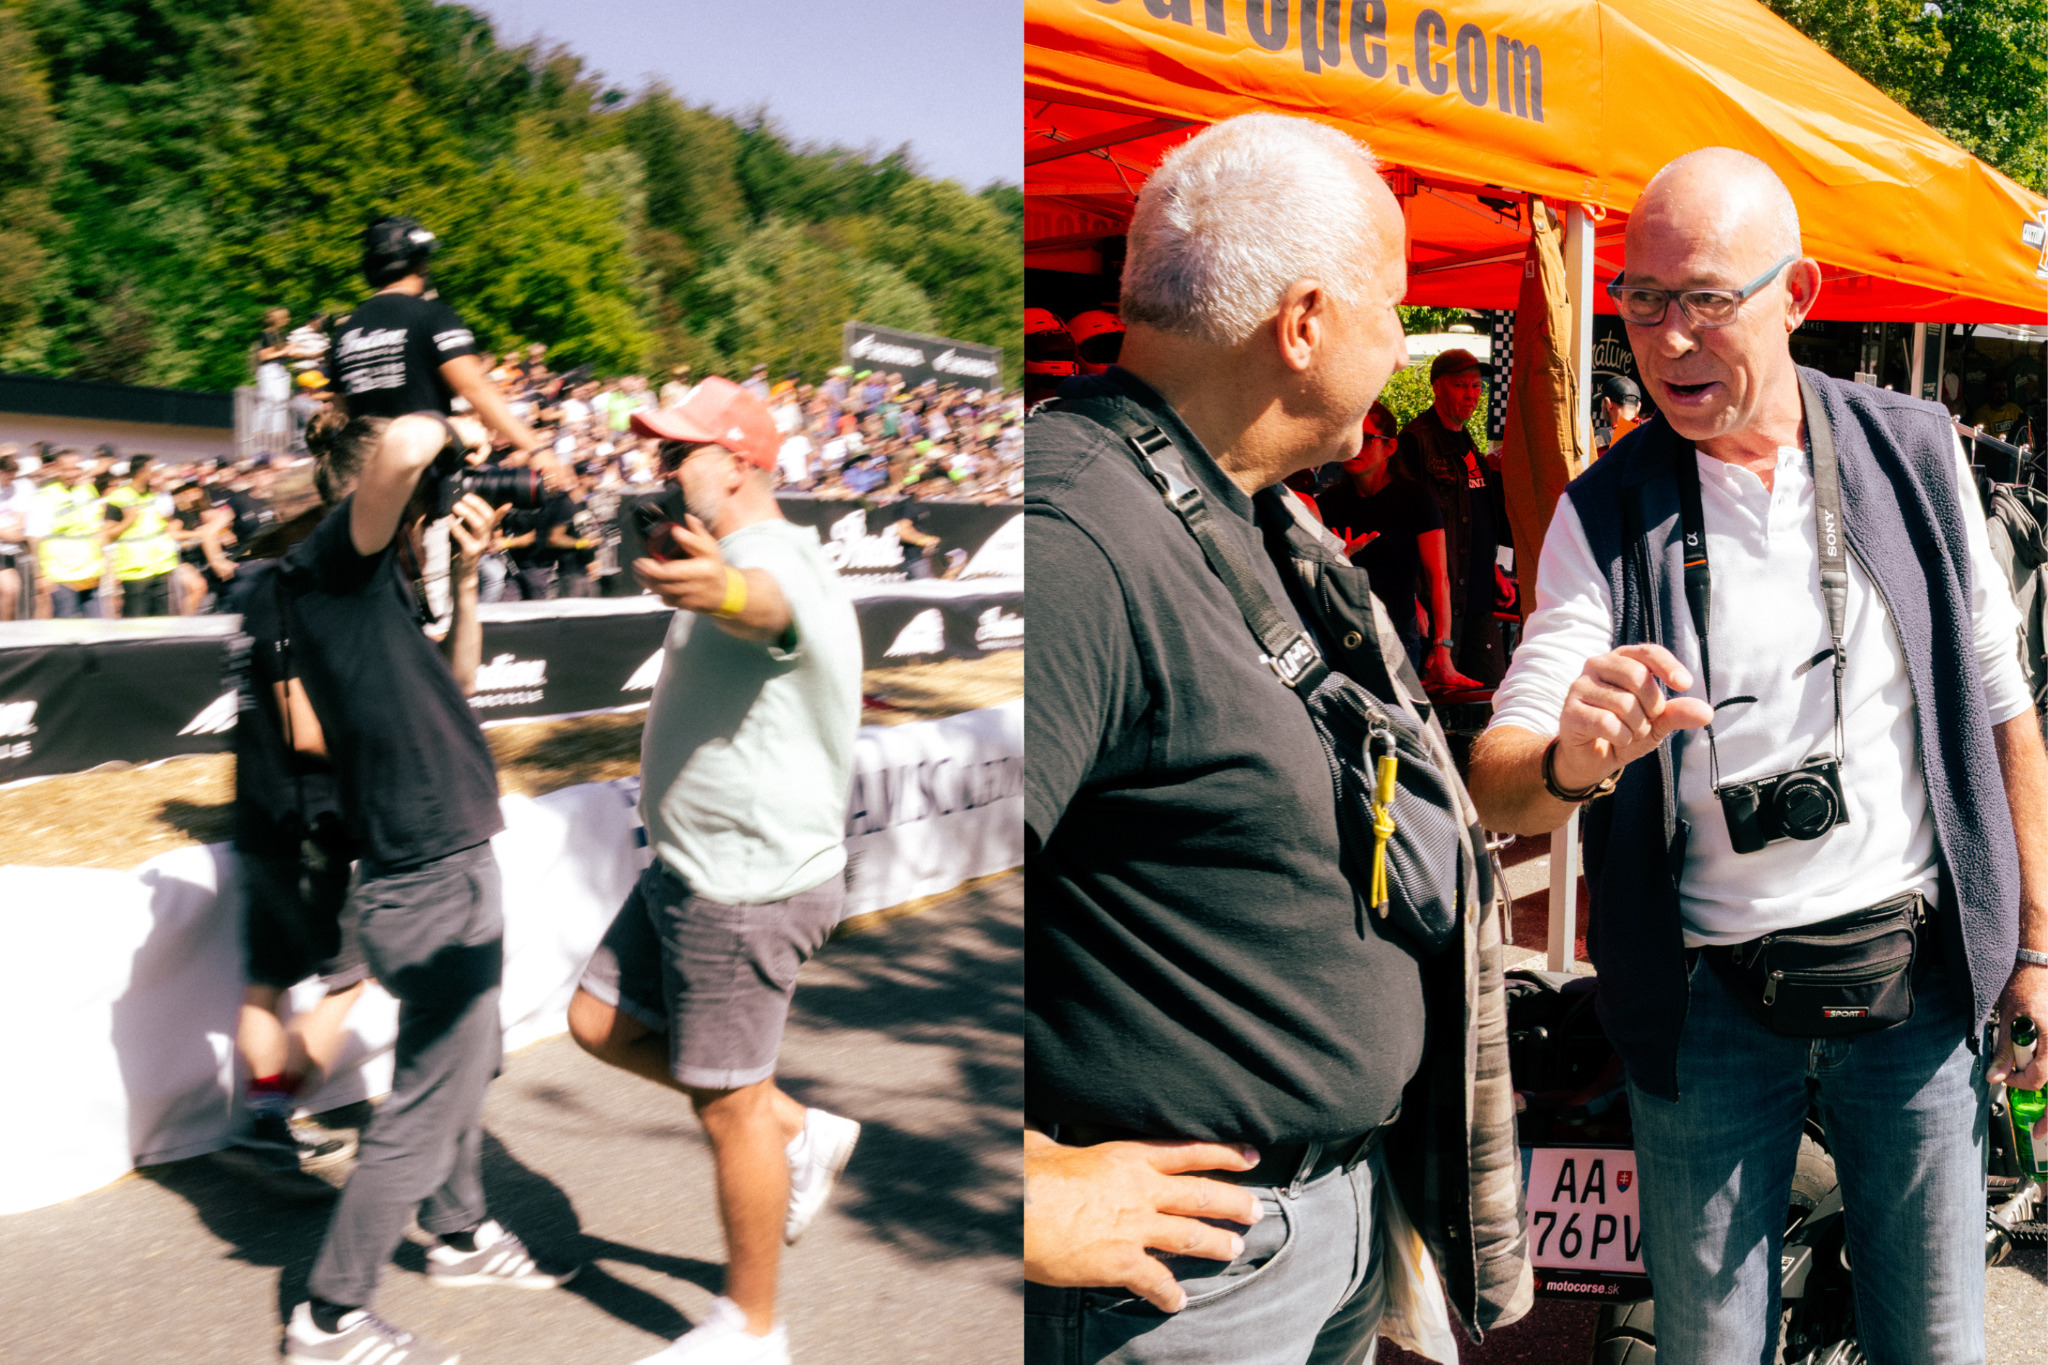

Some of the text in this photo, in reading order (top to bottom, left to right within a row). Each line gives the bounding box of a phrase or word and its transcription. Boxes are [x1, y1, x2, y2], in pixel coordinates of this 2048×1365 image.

[1096, 0, 1544, 123] ope.com
[1825, 509, 1838, 557] SONY
[1757, 776, 1779, 786] SONY
[1552, 1159, 1605, 1204] AA
[1526, 1211, 1641, 1262] 76PV
[1546, 1281, 1619, 1295] motocorse.sk
